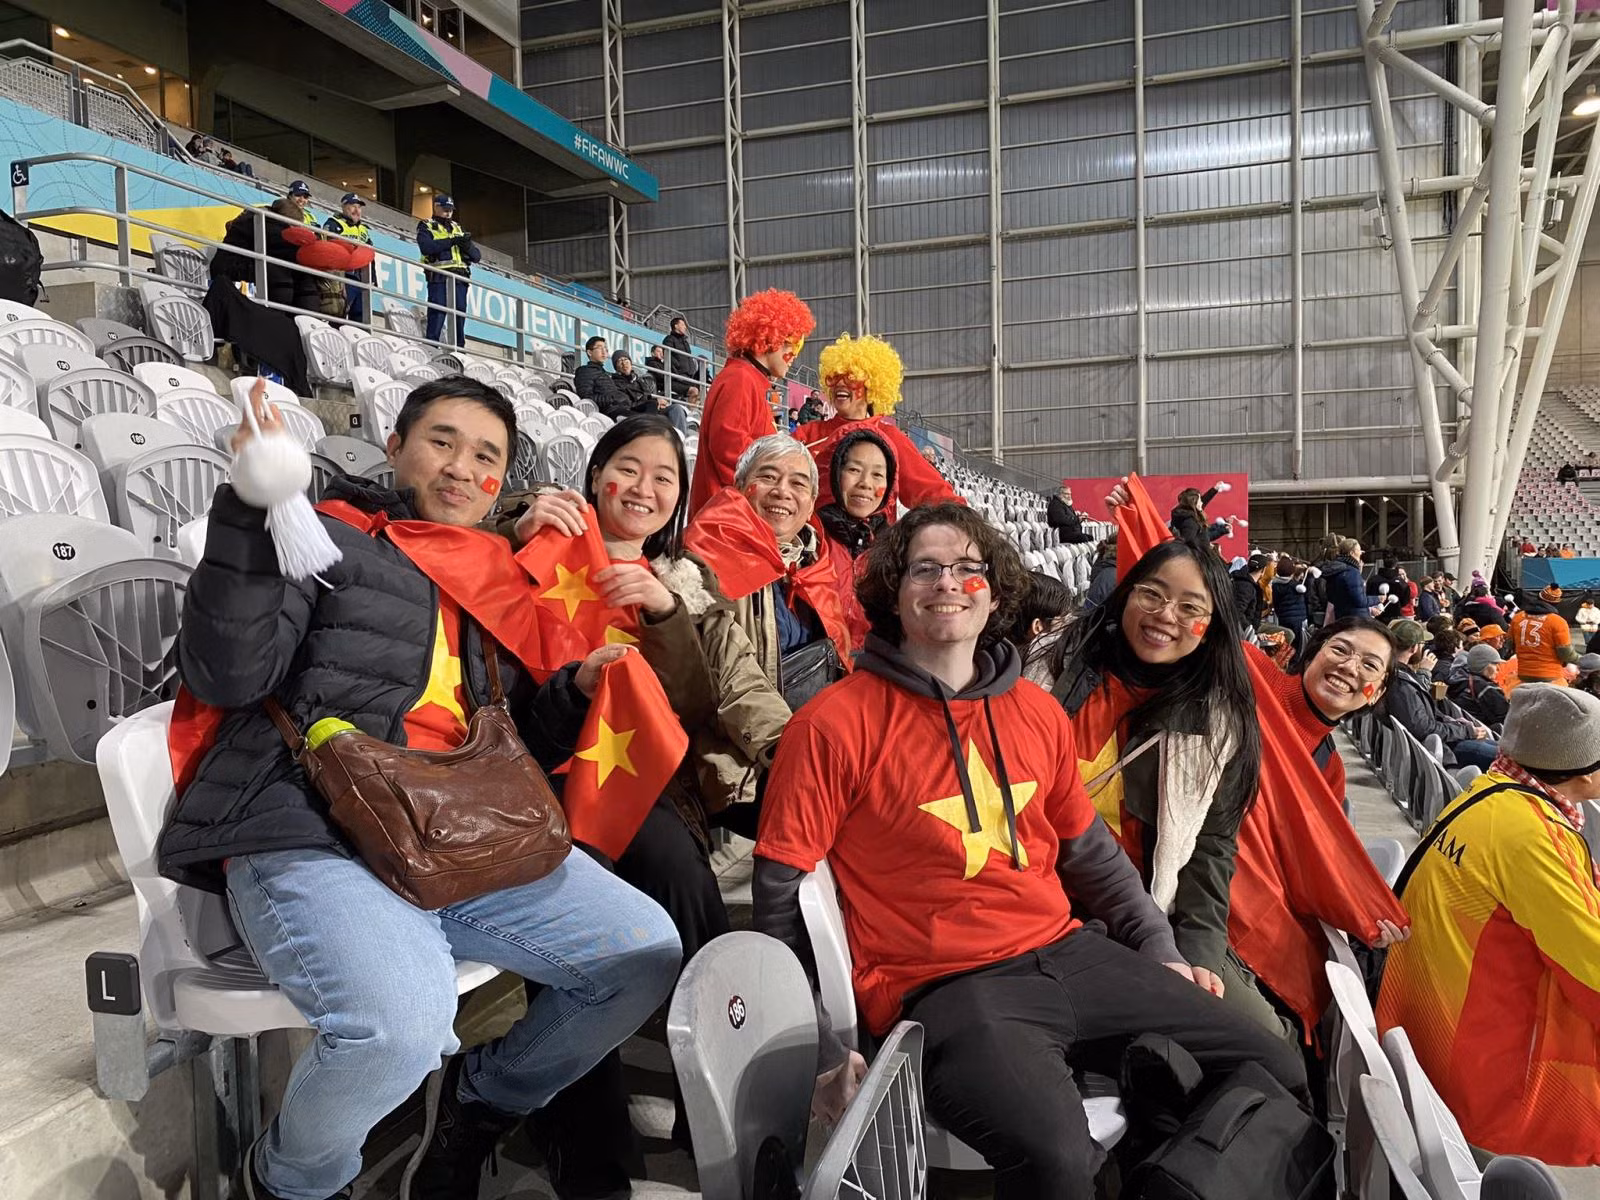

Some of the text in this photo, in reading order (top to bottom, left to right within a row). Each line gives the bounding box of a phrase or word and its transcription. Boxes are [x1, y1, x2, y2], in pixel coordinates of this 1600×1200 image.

[573, 133, 629, 180] #FIFAWWC
[375, 252, 428, 301] FIF
[54, 545, 72, 557] 187
[1519, 619, 1543, 647] 13
[101, 970, 115, 1000] L
[729, 998, 744, 1026] 186
